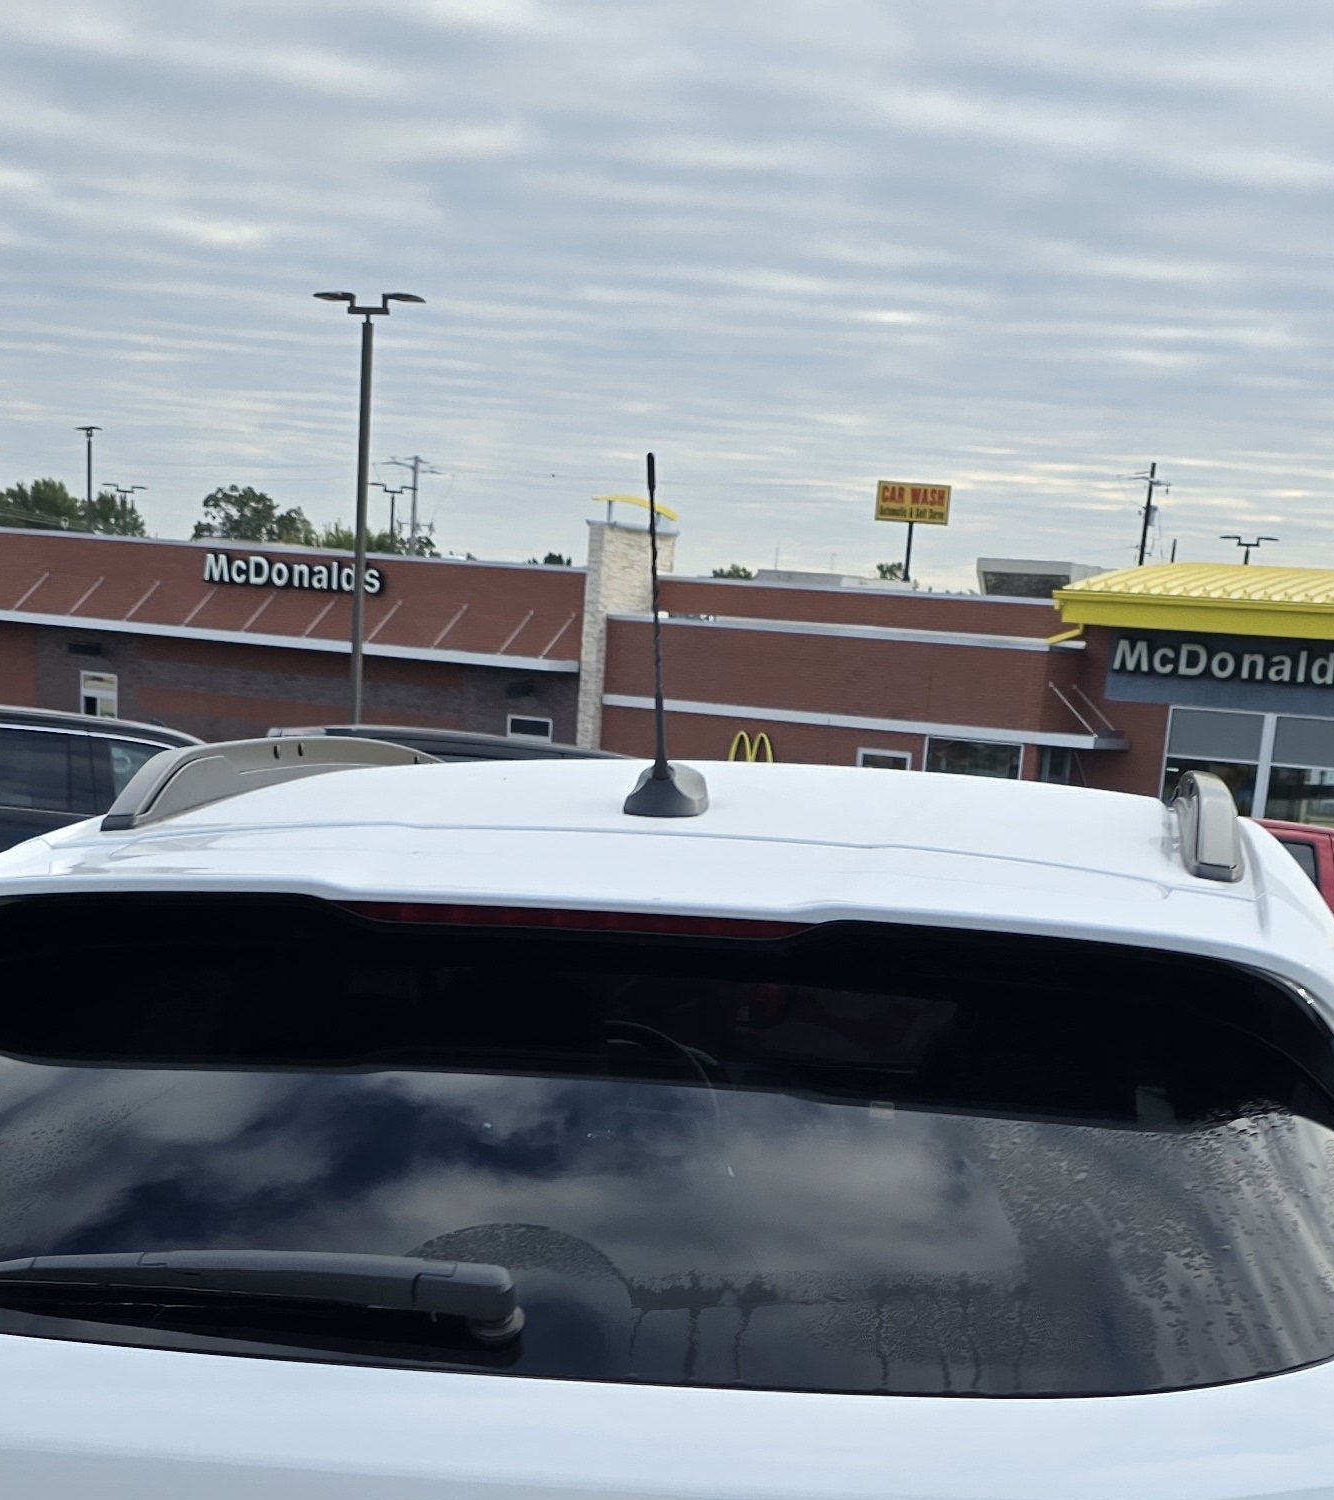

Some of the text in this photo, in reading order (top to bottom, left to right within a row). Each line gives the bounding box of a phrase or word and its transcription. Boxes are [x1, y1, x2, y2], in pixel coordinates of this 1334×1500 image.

[882, 485, 946, 507] CAR WASH
[203, 553, 381, 594] McDonalds
